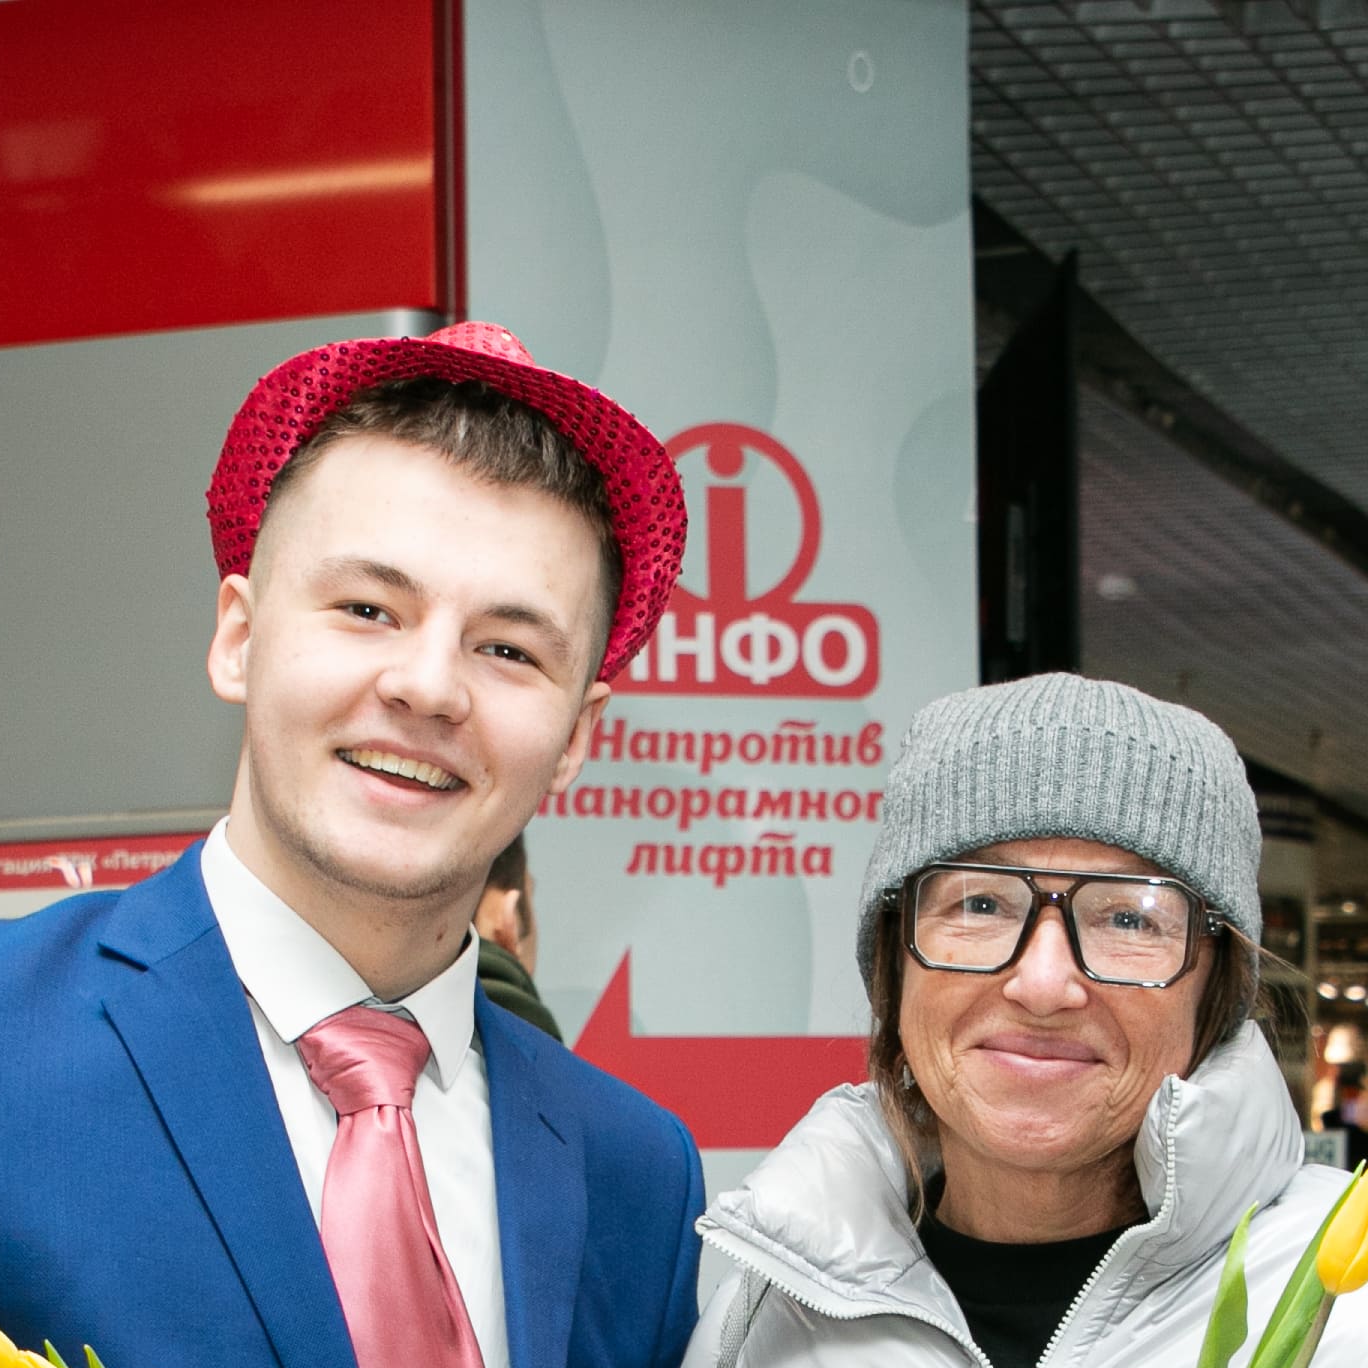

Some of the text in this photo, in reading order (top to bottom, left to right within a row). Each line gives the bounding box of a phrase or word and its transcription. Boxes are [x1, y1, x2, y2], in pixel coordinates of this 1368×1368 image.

[587, 716, 885, 776] Напротив
[536, 784, 884, 832] панорамног
[626, 831, 836, 889] лифта
